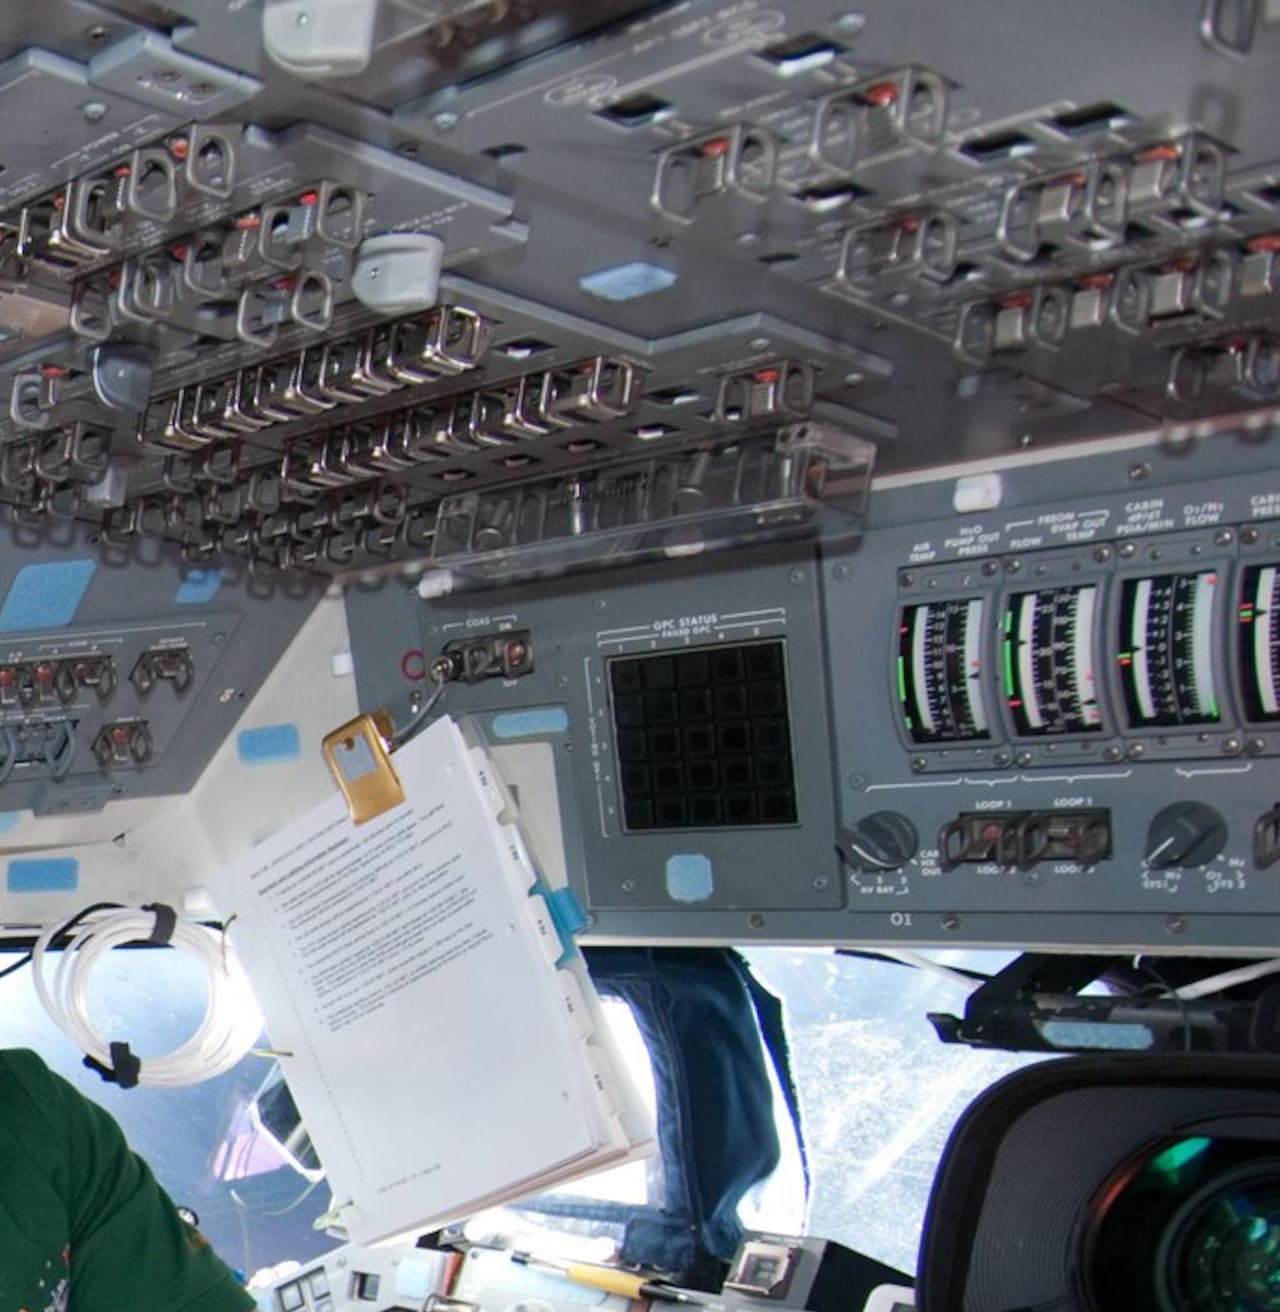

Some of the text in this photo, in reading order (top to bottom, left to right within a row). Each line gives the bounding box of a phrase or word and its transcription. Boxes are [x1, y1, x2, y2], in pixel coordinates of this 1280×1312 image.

[1125, 498, 1164, 513] CABIN
[1185, 512, 1220, 526] FLOW
[944, 532, 1000, 548] PUMP OUT
[1011, 536, 1042, 549] FLOW
[912, 542, 931, 552] AIR
[958, 544, 989, 556] PRESS
[909, 551, 936, 562] TEMP
[653, 613, 718, 630] GPC STATUS
[662, 626, 712, 638] FAILED GPC
[975, 800, 1012, 810] LOOP 1
[1054, 797, 1093, 808] LOOP 1
[920, 850, 940, 859] CAB
